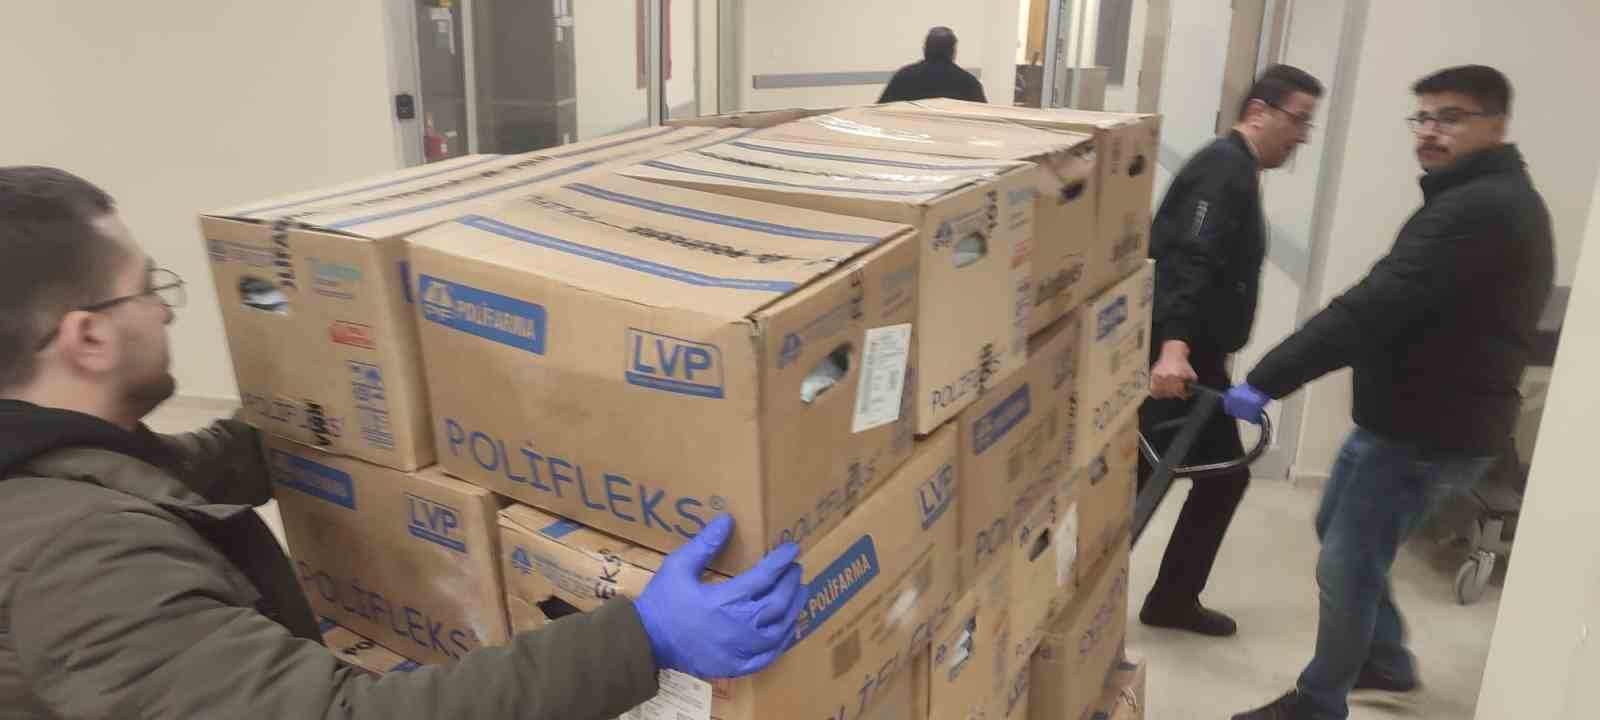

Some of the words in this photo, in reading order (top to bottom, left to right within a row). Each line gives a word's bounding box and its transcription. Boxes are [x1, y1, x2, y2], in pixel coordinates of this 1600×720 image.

[633, 334, 711, 381] LVP
[409, 498, 459, 536] LVP
[808, 553, 871, 619] POLİFARMA
